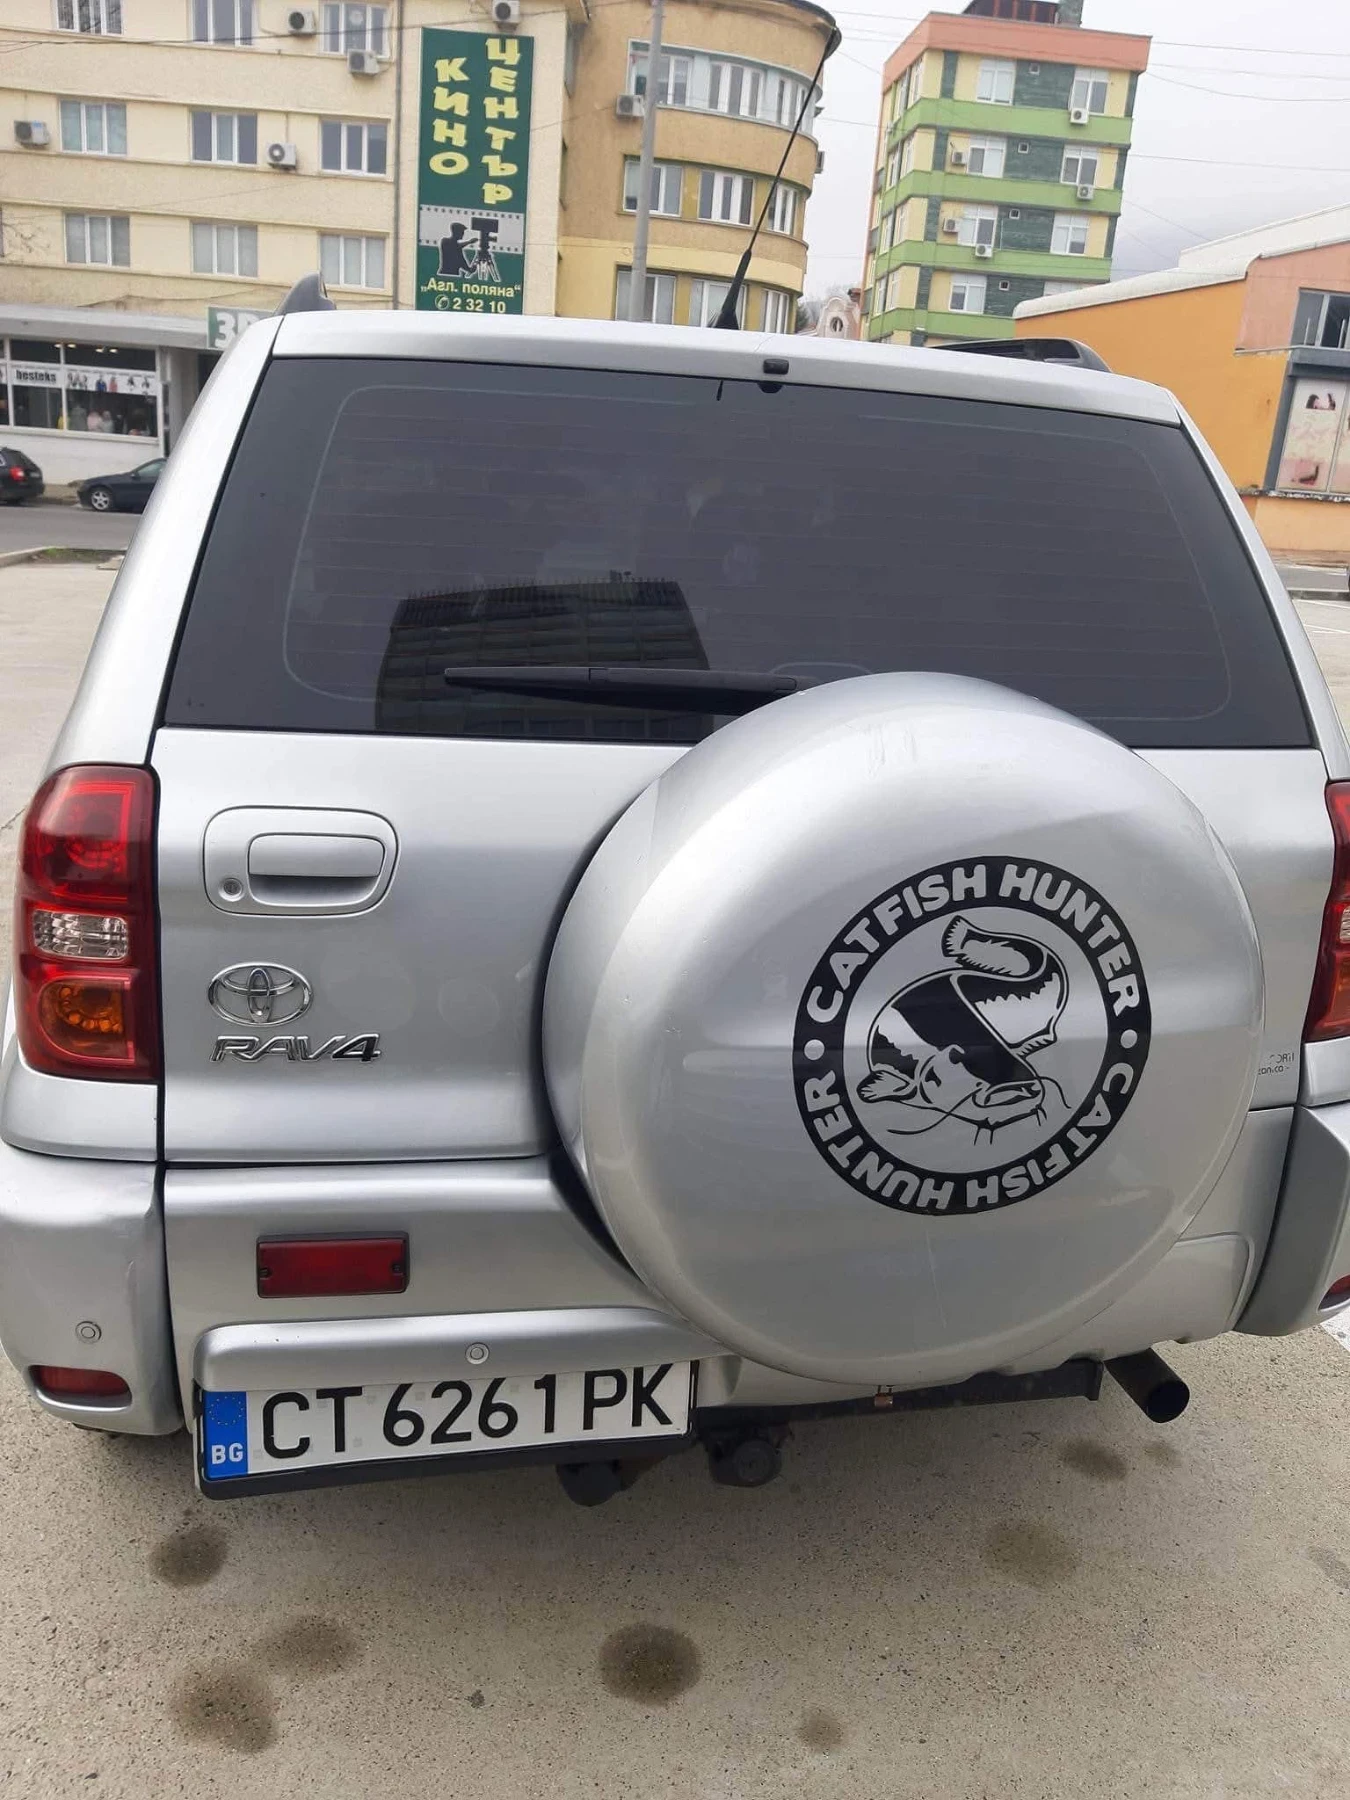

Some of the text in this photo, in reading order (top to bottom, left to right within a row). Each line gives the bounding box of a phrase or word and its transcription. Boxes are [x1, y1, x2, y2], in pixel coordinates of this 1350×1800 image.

[429, 57, 470, 175] КИНО
[481, 38, 521, 204] ЦЕНТЪР
[452, 297, 507, 313] 2 32 10
[806, 863, 1141, 1023] CATFISH HUNTER
[209, 1033, 382, 1063] RAV4
[803, 1061, 1135, 1210] CATFISH HUNTER
[210, 1442, 244, 1465] BG
[262, 1362, 674, 1459] CT 6261 PK
